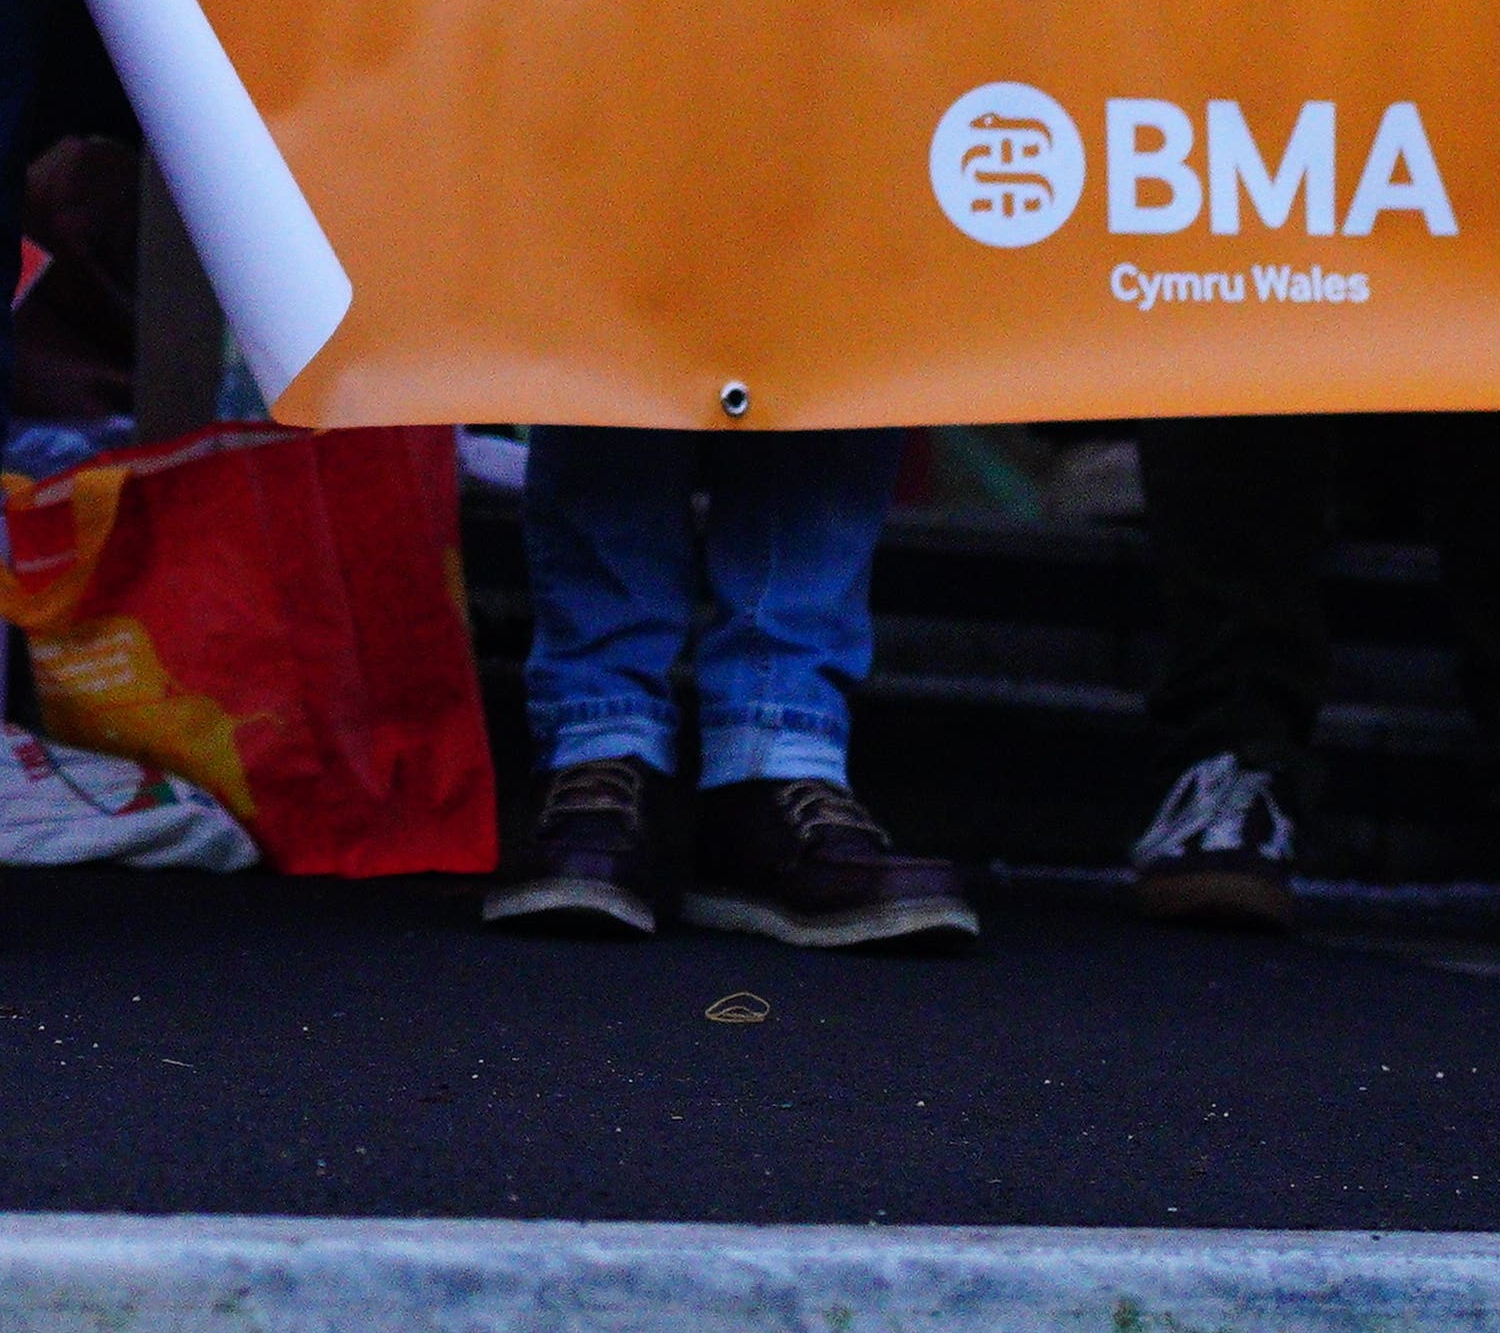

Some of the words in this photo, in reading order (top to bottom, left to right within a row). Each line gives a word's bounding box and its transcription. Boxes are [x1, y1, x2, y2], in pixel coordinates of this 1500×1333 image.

[1105, 97, 1461, 238] BMA
[1109, 261, 1246, 312] Cymru
[1250, 262, 1371, 306] Wales
